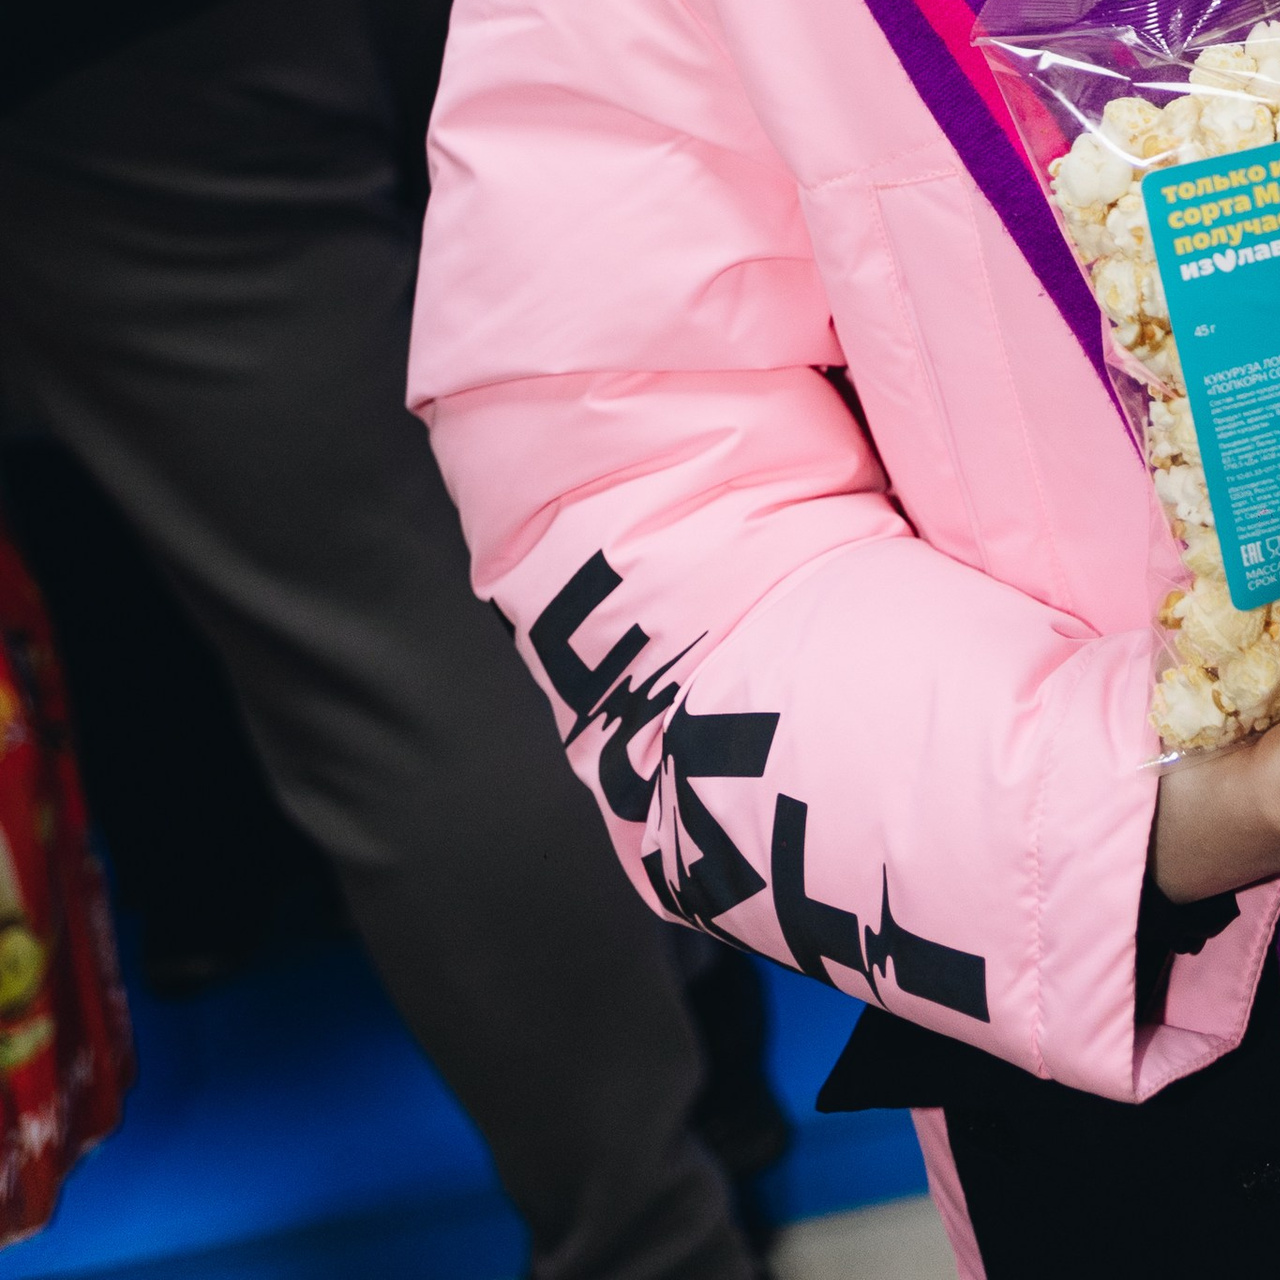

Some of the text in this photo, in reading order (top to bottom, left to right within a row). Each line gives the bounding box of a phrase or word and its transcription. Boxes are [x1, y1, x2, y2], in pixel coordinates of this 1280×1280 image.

[1160, 164, 1267, 204] только
[1167, 194, 1252, 229] сорта
[1203, 361, 1262, 386] КУКУРУЗА
[1206, 372, 1268, 395] «ПОПКОРН
[1247, 575, 1277, 591] СРОК
